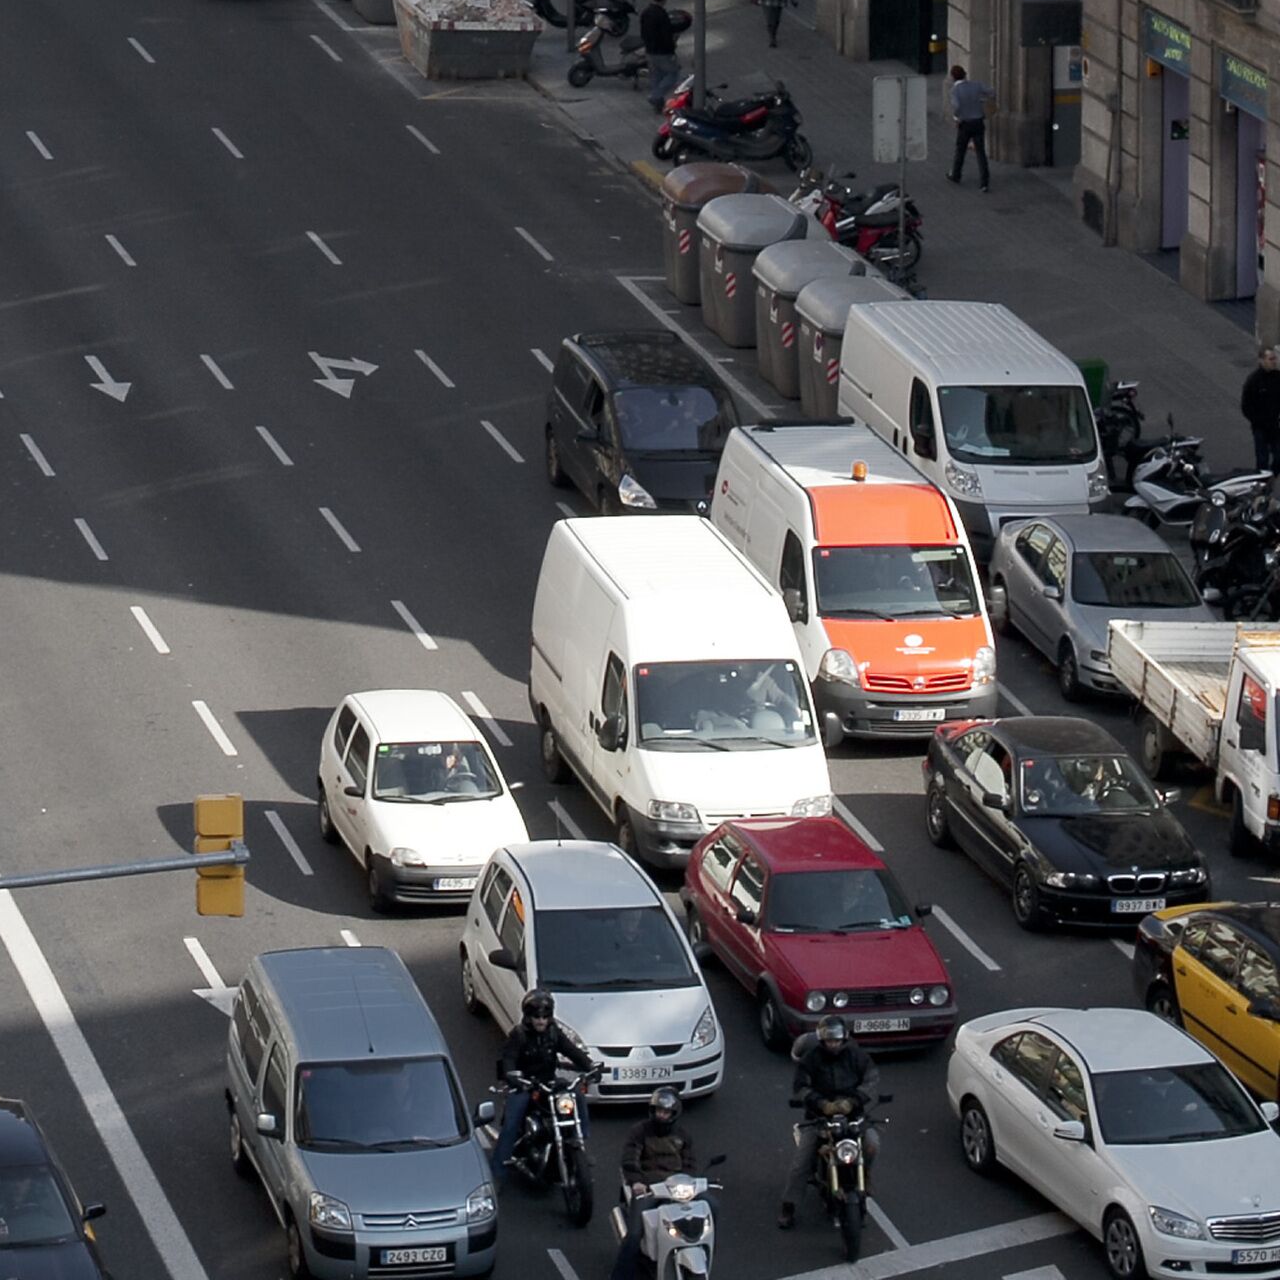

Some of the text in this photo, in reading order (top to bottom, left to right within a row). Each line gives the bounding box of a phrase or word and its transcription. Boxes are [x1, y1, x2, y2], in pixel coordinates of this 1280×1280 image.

[621, 1067, 671, 1079] 3389 FZN
[389, 1249, 444, 1262] 2493 CZG
[1239, 1251, 1267, 1262] 5570
